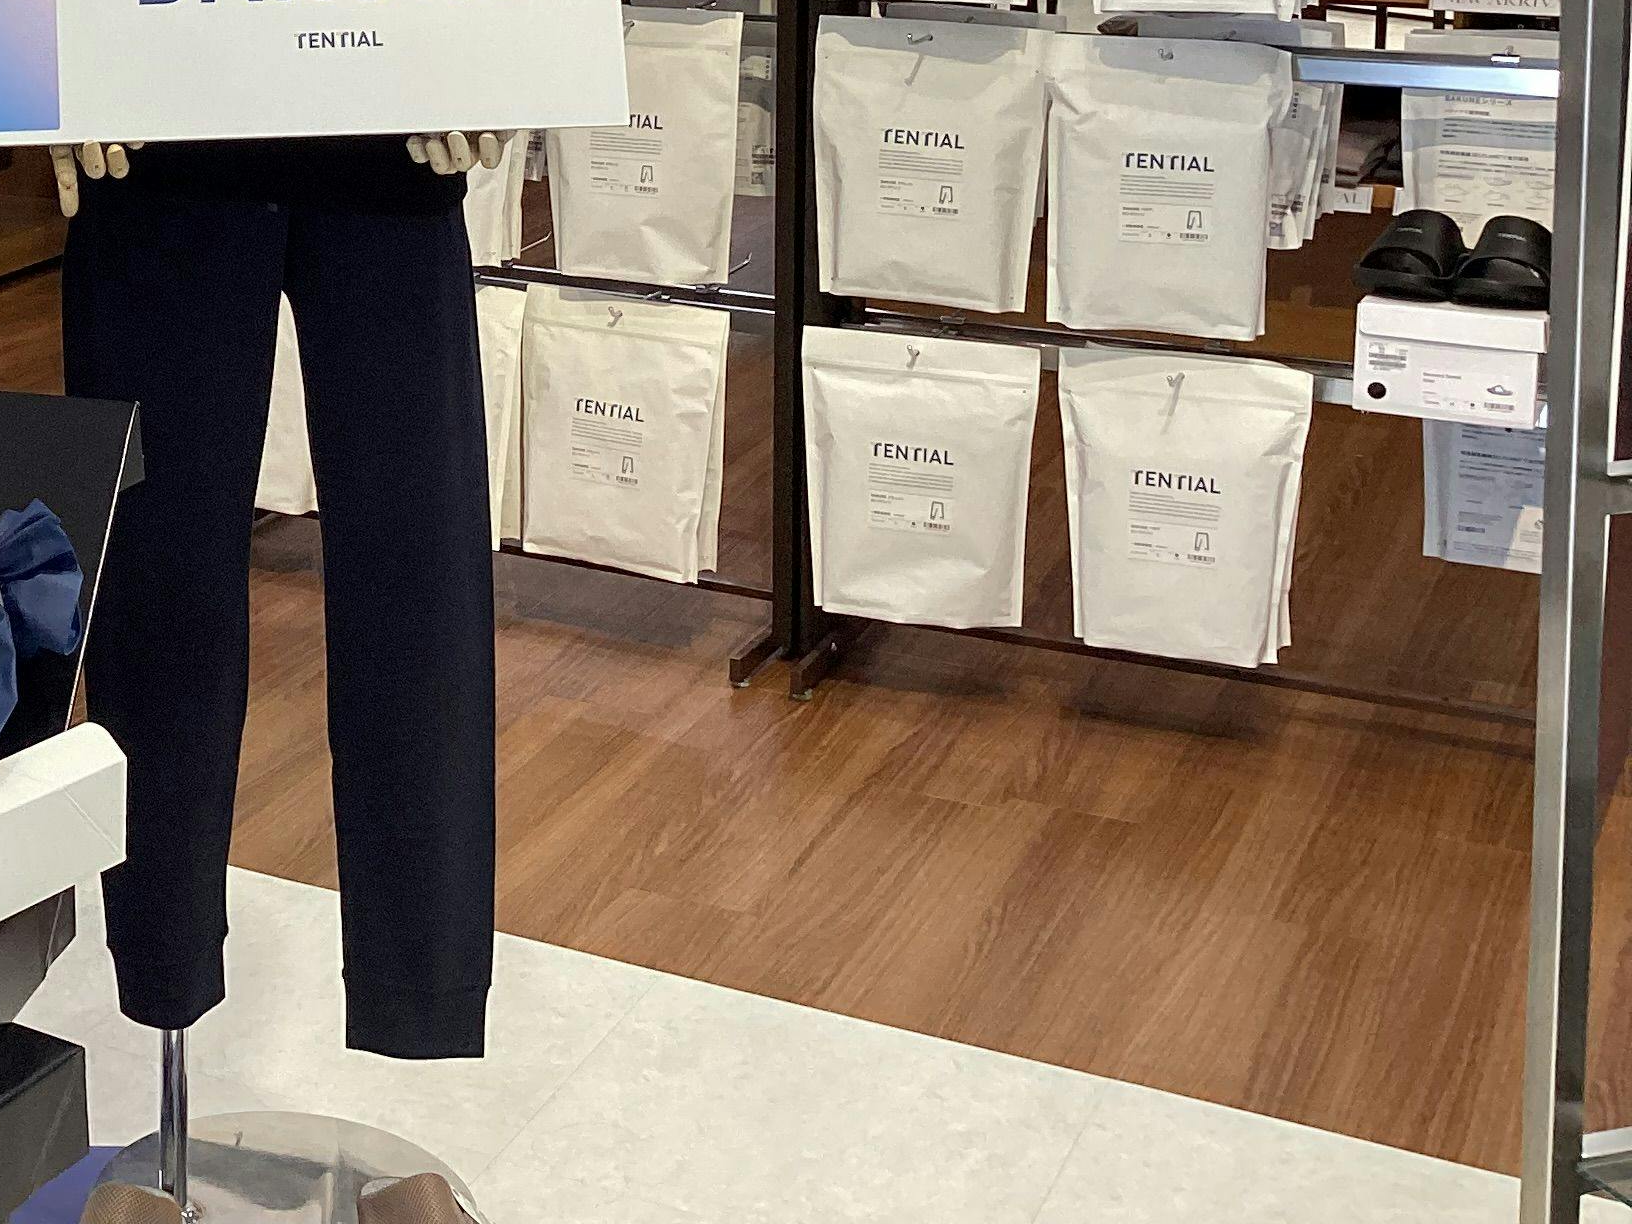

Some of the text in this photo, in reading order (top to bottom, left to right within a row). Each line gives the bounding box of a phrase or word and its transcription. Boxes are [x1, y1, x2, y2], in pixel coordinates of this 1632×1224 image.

[294, 30, 384, 49] TENTIAL
[629, 114, 663, 130] TIAL
[882, 128, 965, 150] TENTIAL
[1123, 152, 1215, 173] TENTIAL
[574, 398, 645, 423] TENTIAL
[871, 442, 954, 466] TENTIAL
[1132, 470, 1222, 495] TENTIAL
